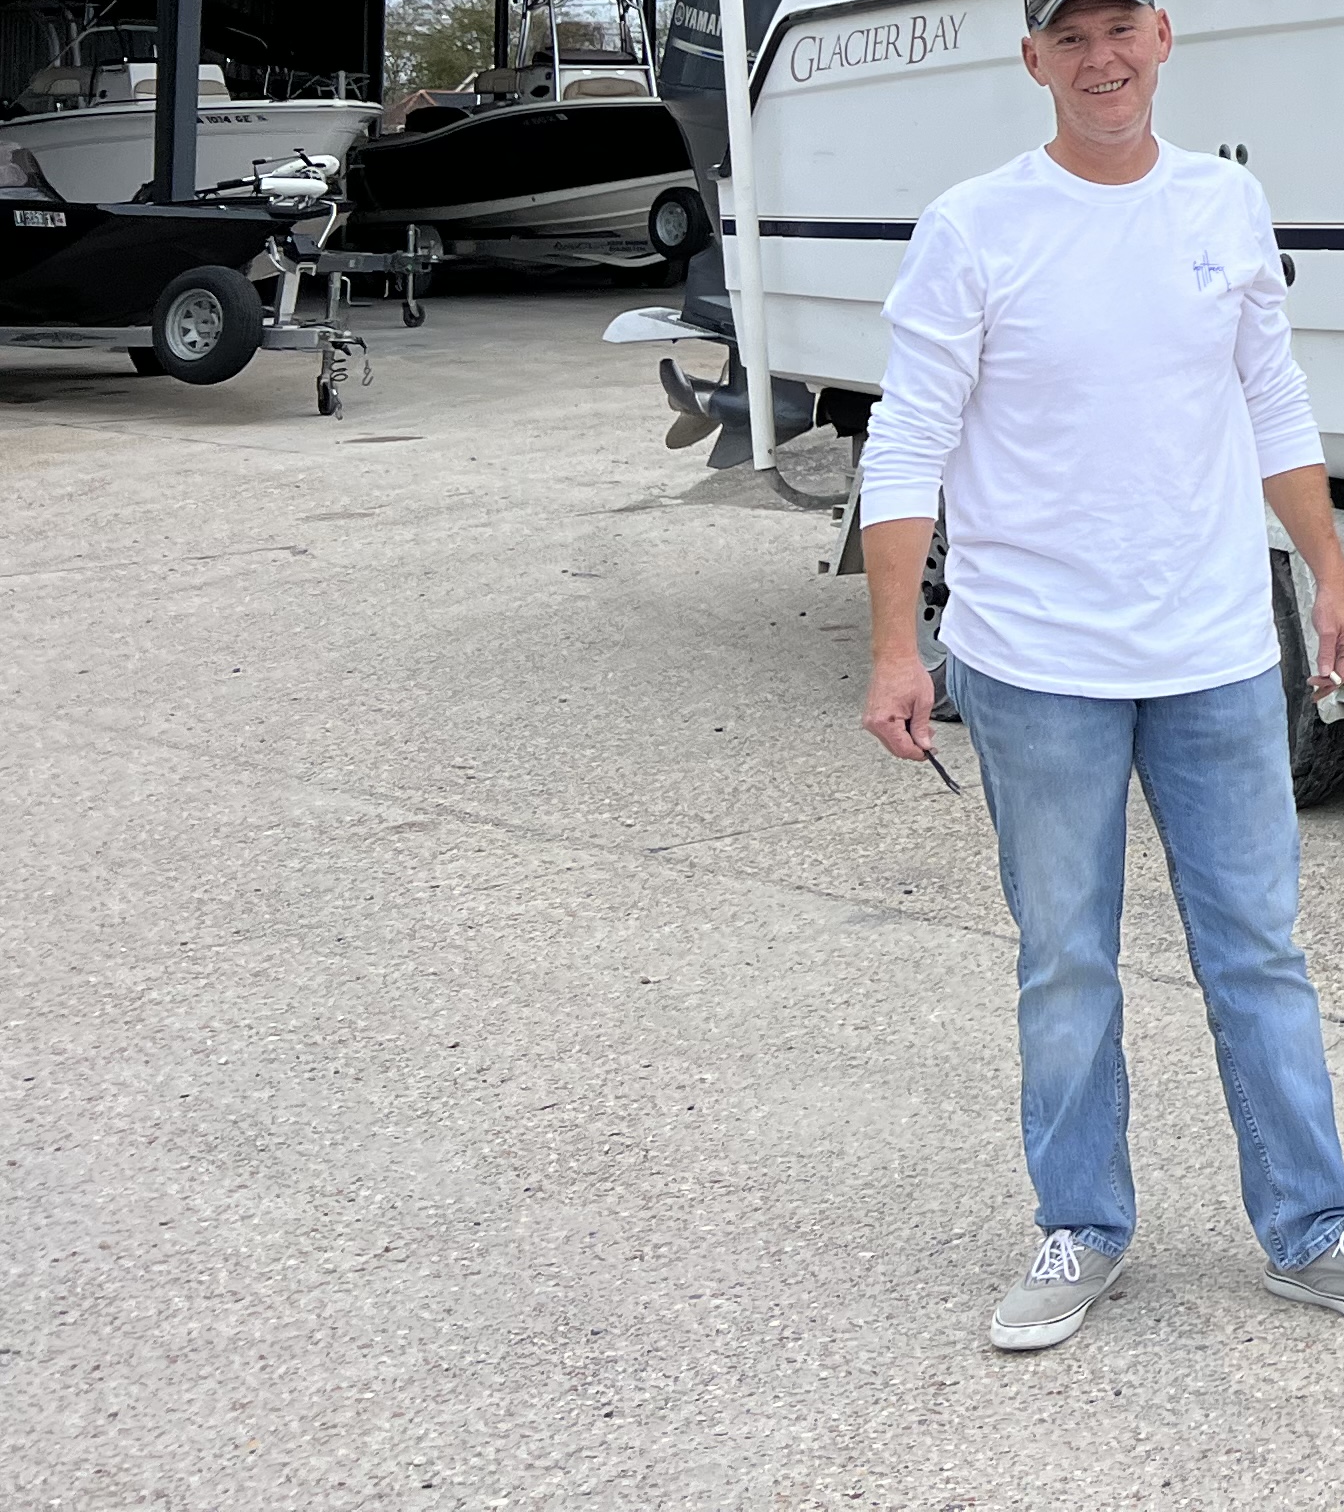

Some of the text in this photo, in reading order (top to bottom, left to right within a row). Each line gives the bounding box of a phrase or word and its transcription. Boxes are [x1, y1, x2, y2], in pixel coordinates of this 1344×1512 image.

[685, 6, 722, 37] YAMA
[790, 12, 968, 83] GLACIER BAY
